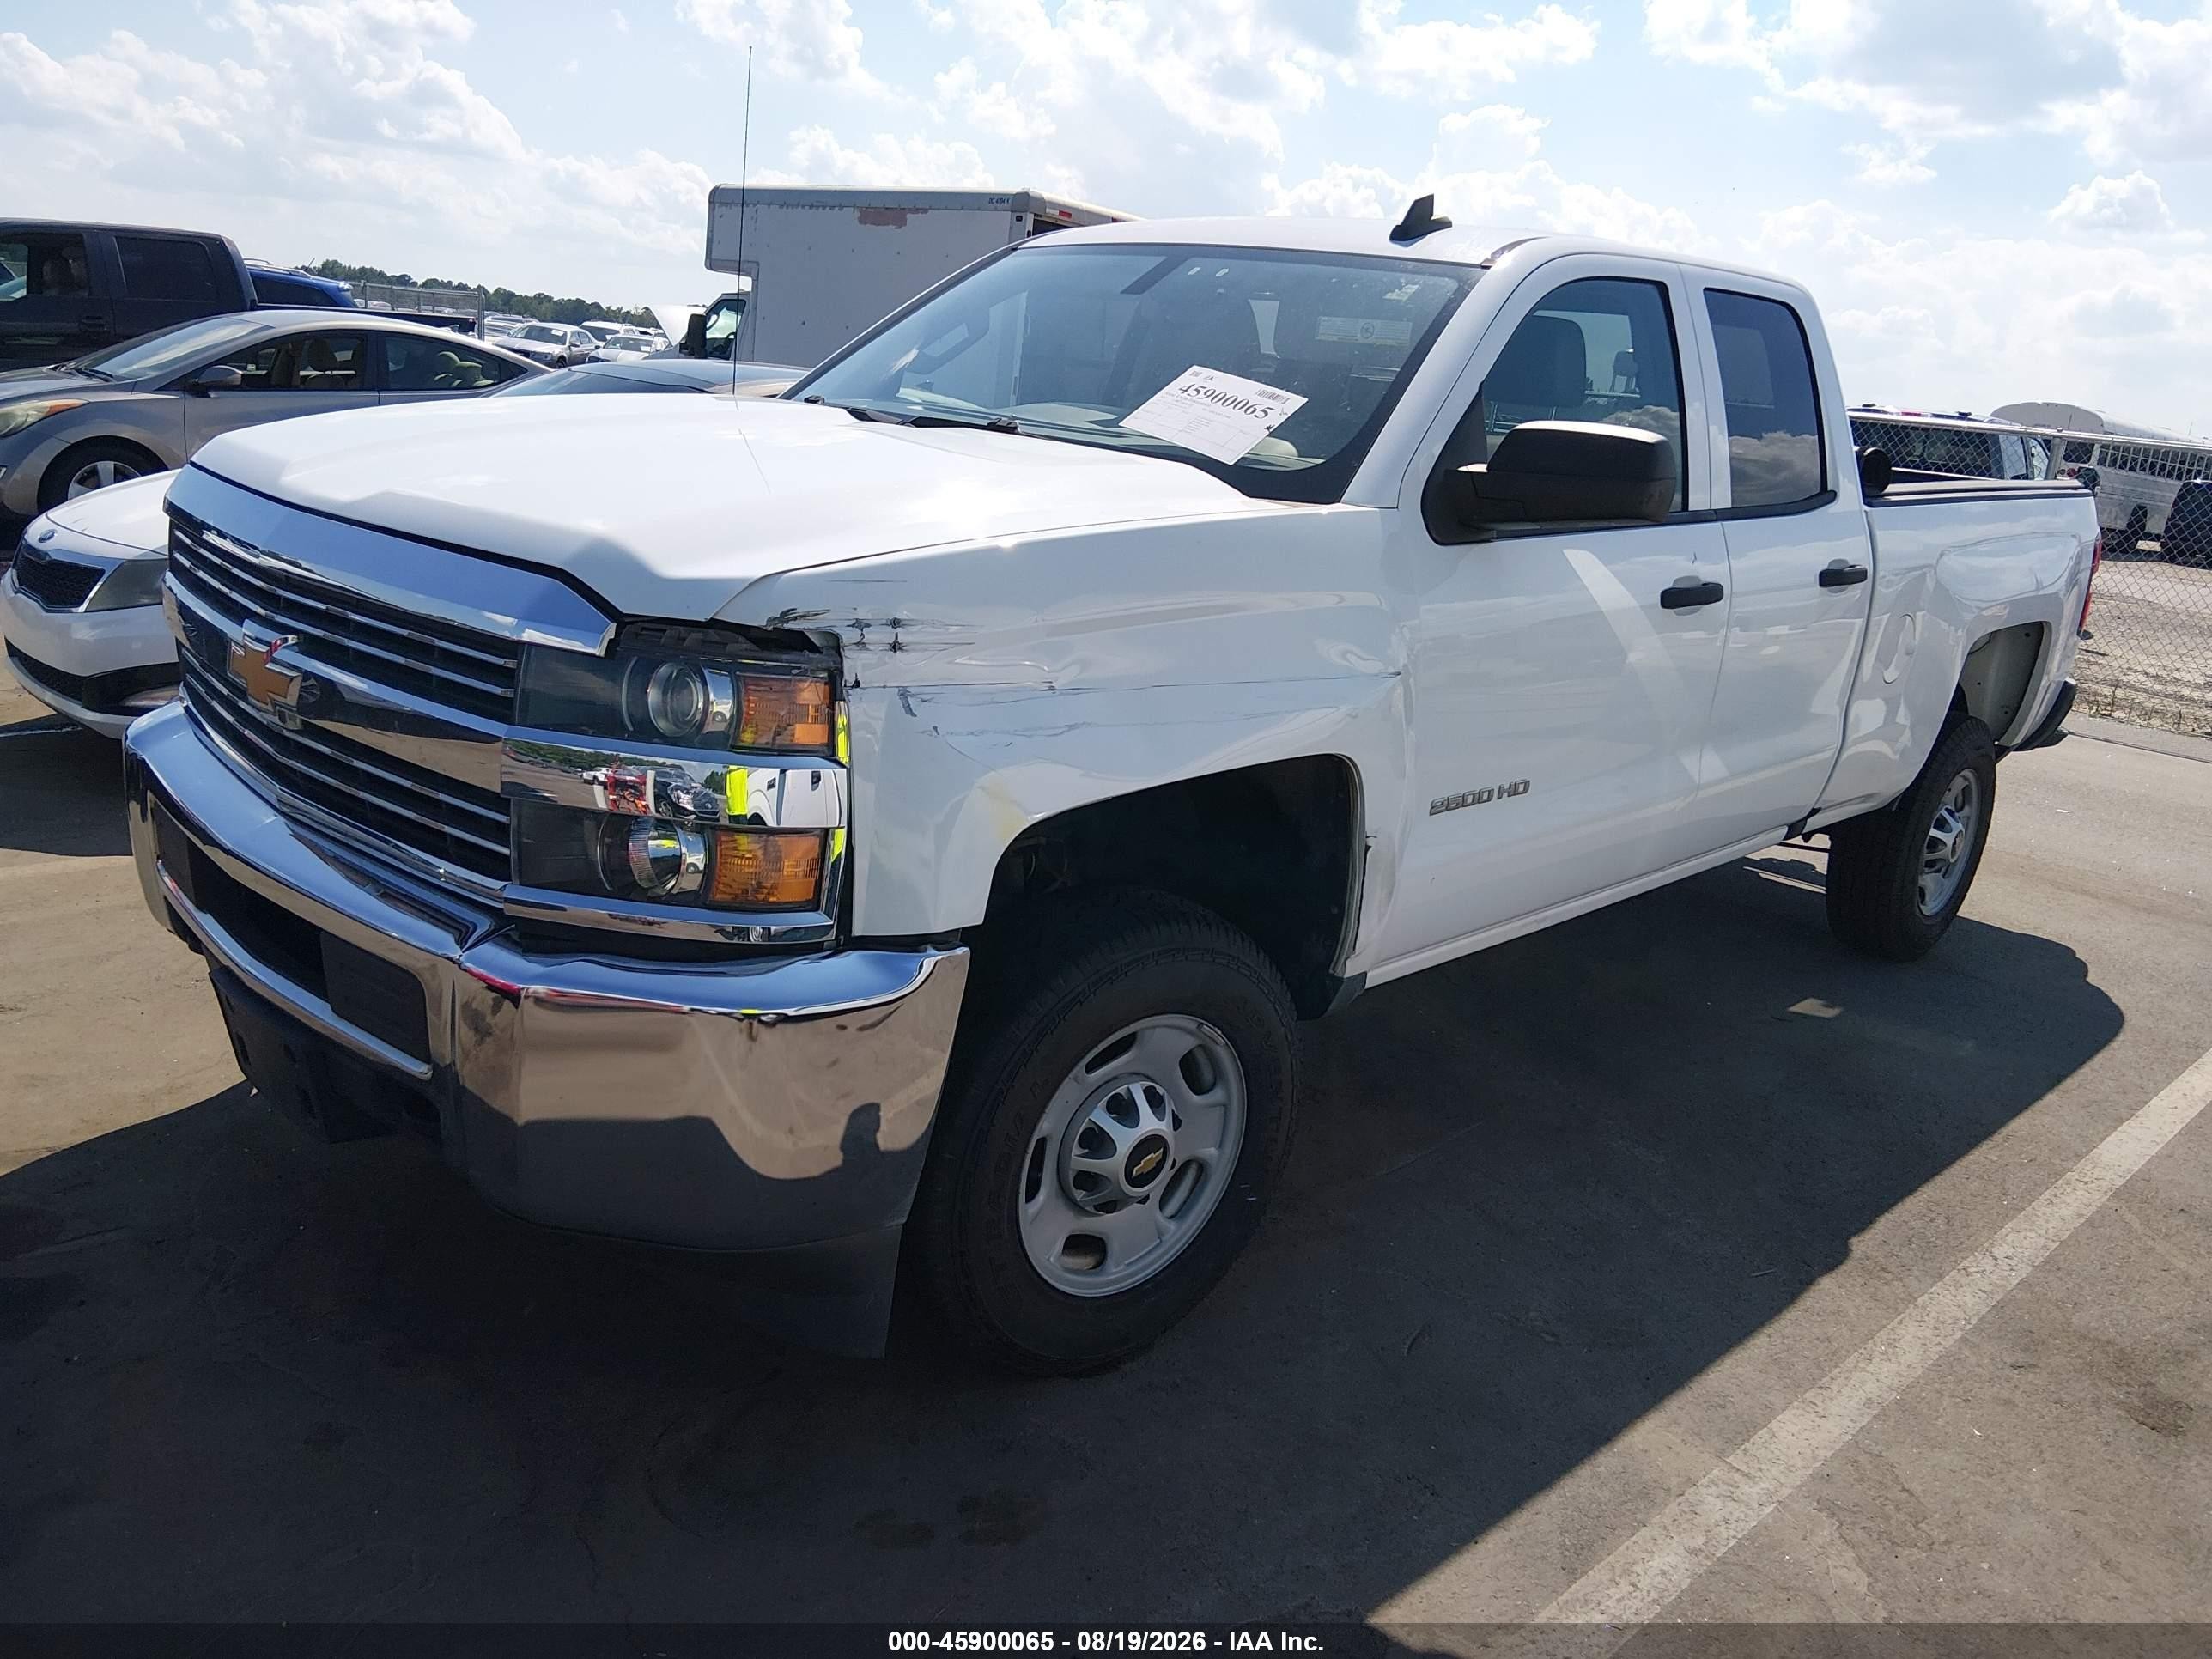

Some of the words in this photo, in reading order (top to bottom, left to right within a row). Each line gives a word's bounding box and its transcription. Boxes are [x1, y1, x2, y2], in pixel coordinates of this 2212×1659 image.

[1178, 383, 1275, 419] 45900065
[1429, 786, 1494, 816] 2500
[1497, 779, 1530, 799] HD
